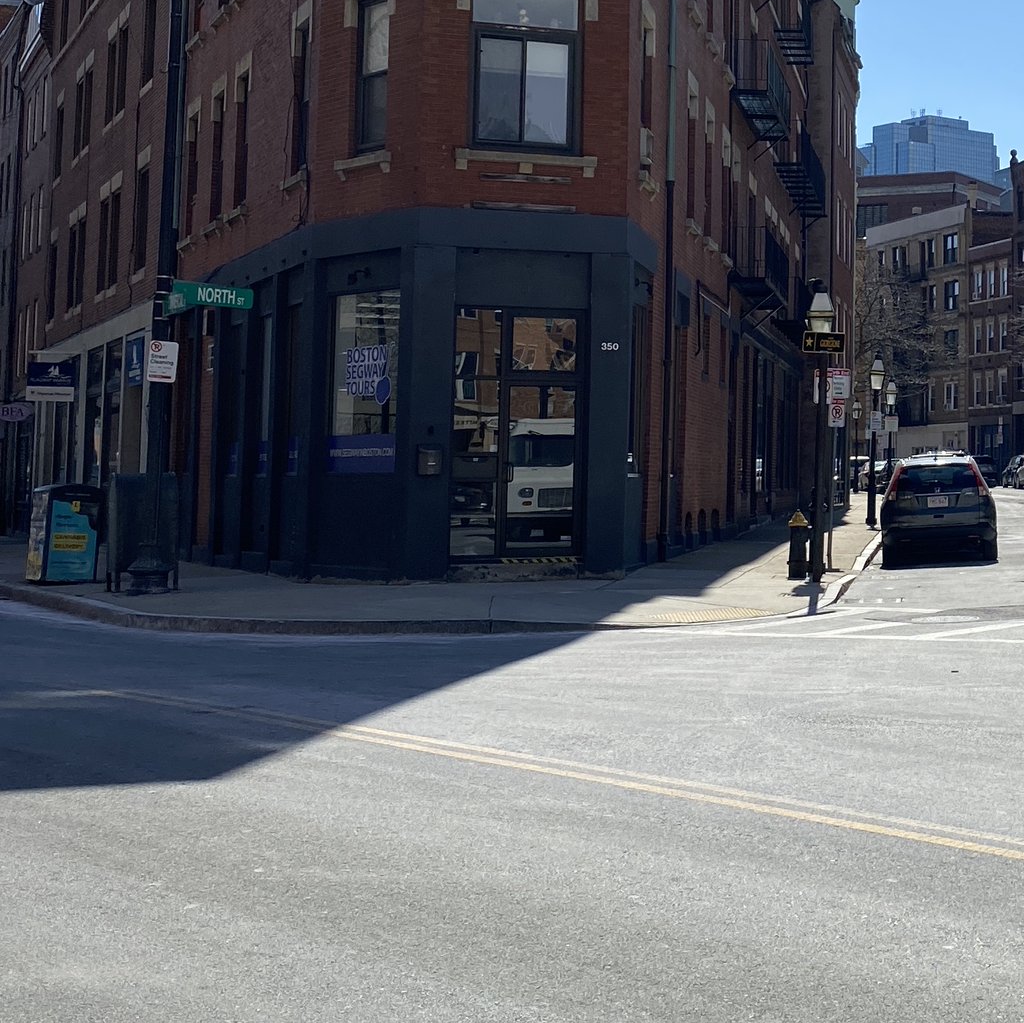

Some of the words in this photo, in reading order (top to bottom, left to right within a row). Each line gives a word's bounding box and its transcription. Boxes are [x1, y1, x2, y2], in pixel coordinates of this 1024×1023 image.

[197, 287, 236, 305] NORTH
[236, 297, 245, 306] ST
[601, 342, 619, 351] 350
[150, 359, 174, 367] Cleaning
[347, 346, 387, 364] BOSTON
[346, 363, 382, 380] SEGWAY
[346, 380, 376, 396] TOURS
